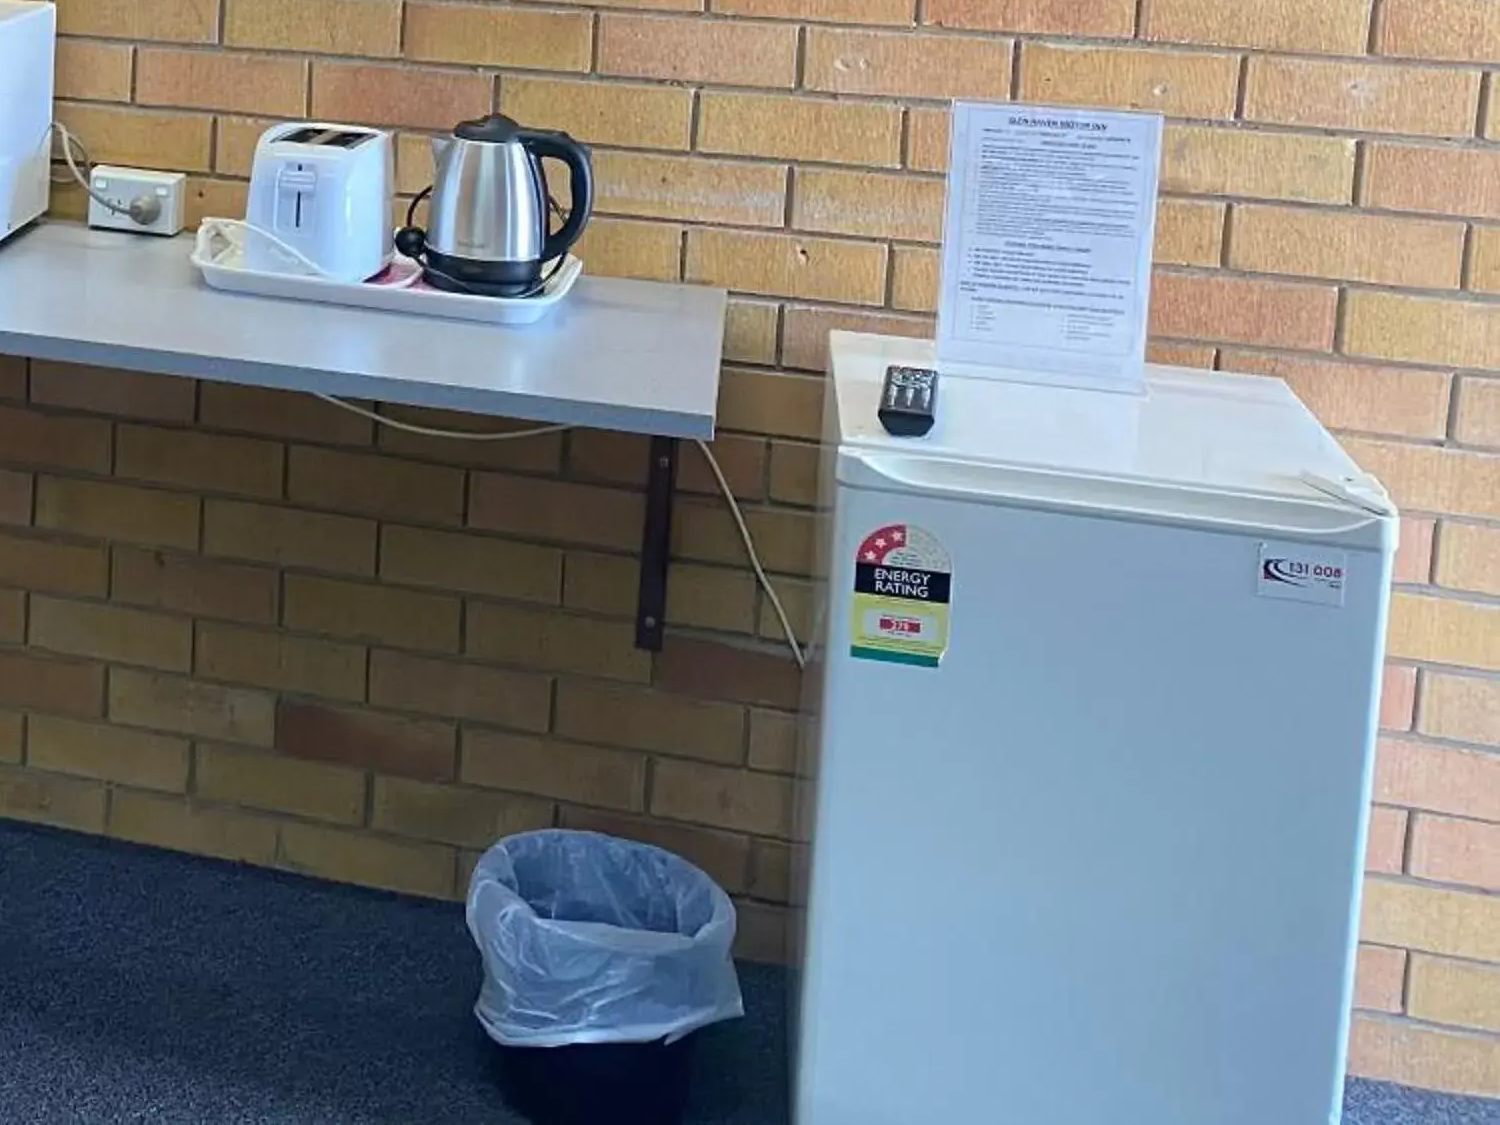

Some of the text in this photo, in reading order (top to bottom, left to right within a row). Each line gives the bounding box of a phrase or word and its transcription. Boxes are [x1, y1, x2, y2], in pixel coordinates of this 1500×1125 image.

[874, 568, 931, 585] ENERGY
[1289, 562, 1342, 578] 131 008
[875, 580, 929, 598] RATING
